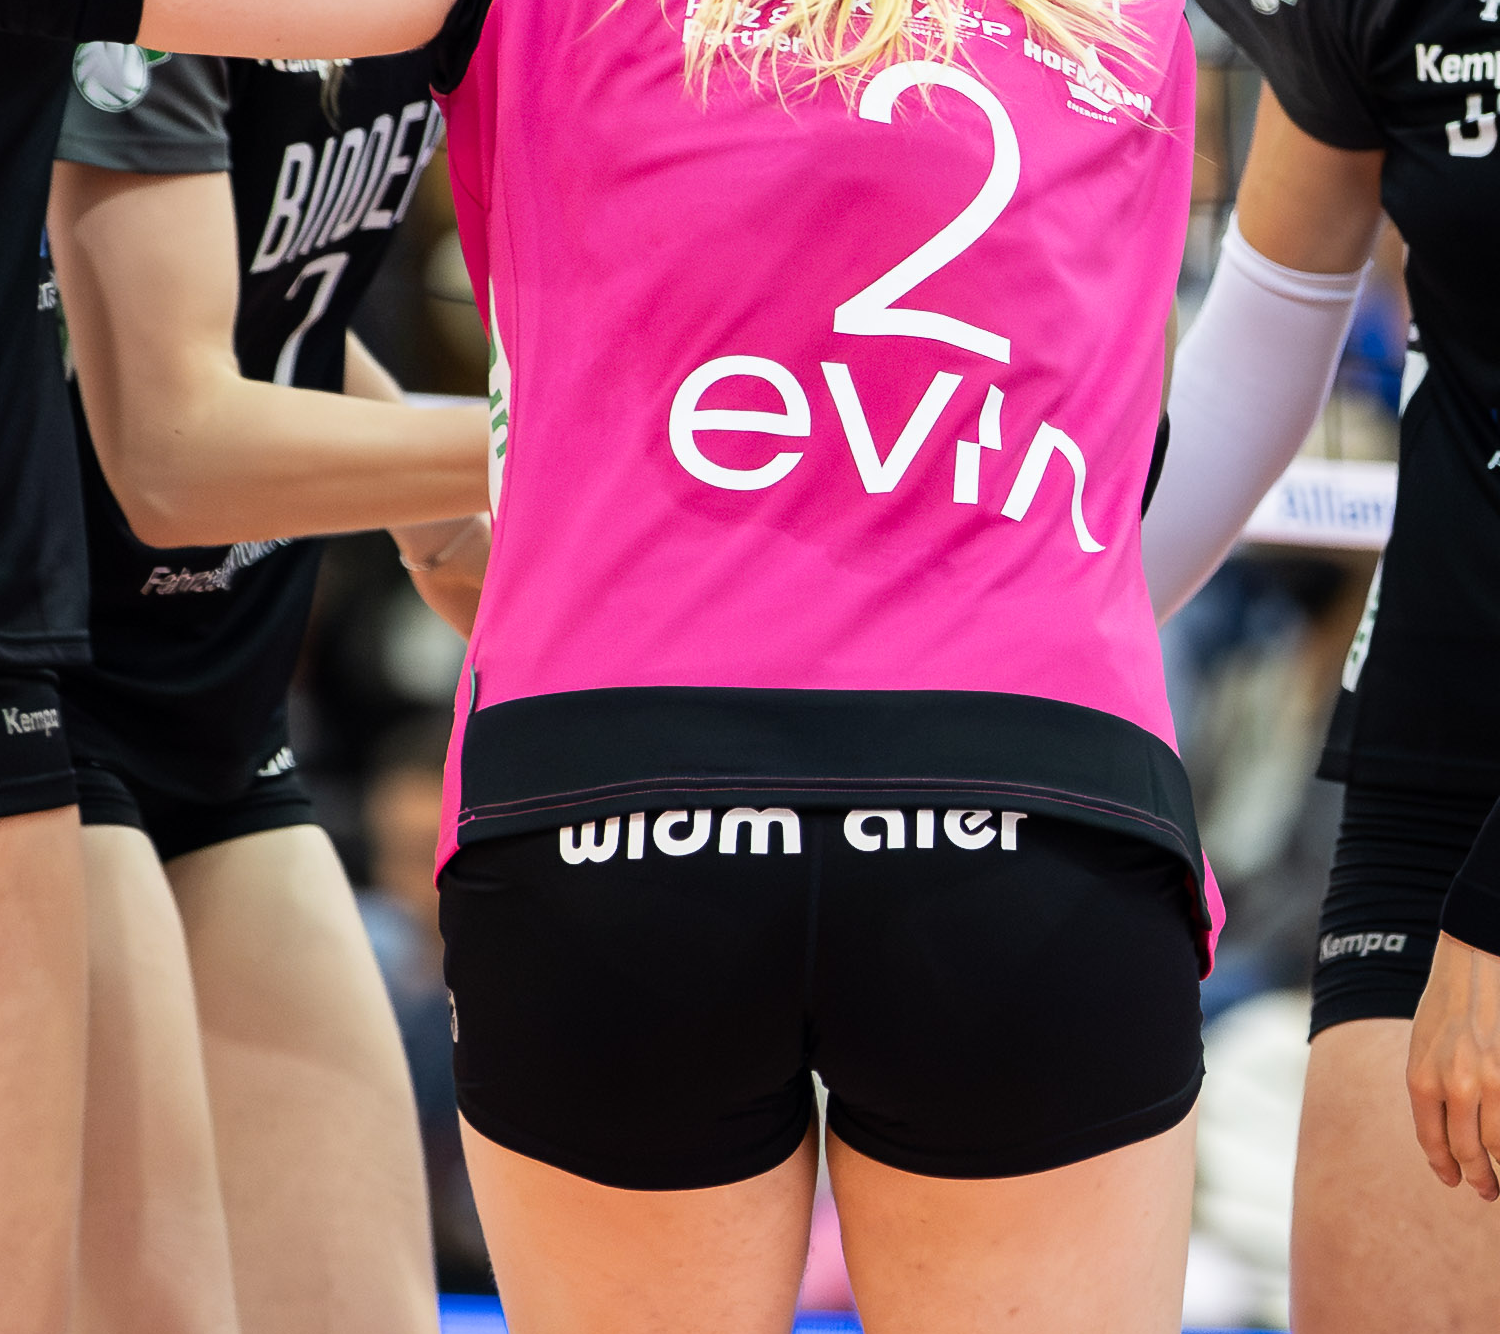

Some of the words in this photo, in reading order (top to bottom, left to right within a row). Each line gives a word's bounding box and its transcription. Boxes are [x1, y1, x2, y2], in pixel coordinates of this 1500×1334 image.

[833, 60, 1018, 365] 2
[668, 354, 1107, 554] evin
[1278, 485, 1388, 530] Allian
